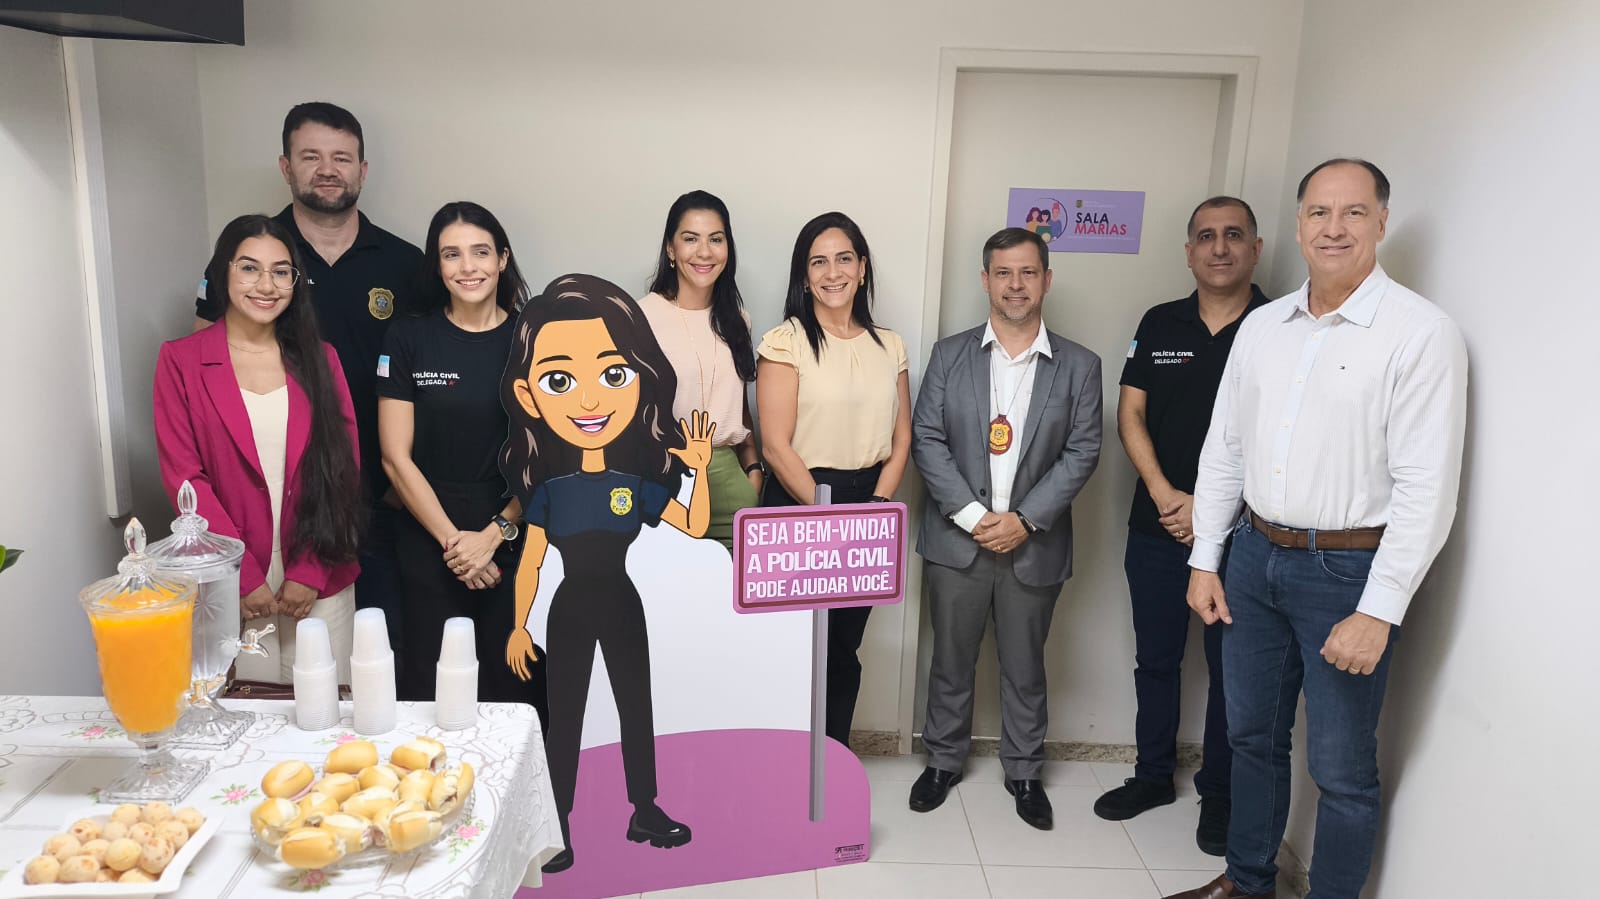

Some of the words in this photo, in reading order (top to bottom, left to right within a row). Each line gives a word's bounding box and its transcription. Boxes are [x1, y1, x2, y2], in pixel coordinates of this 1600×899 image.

[1074, 224, 1127, 235] MARIAS
[1075, 212, 1109, 224] SALA
[747, 521, 789, 546] SEJA
[794, 517, 896, 544] BEM-VINDA!
[747, 553, 762, 574] A
[767, 546, 842, 573] POLÍCIA
[847, 547, 894, 568] CIVIL
[746, 580, 787, 599] PODE
[790, 576, 848, 596] AJUDAR
[852, 570, 893, 592] VOCÊ.
